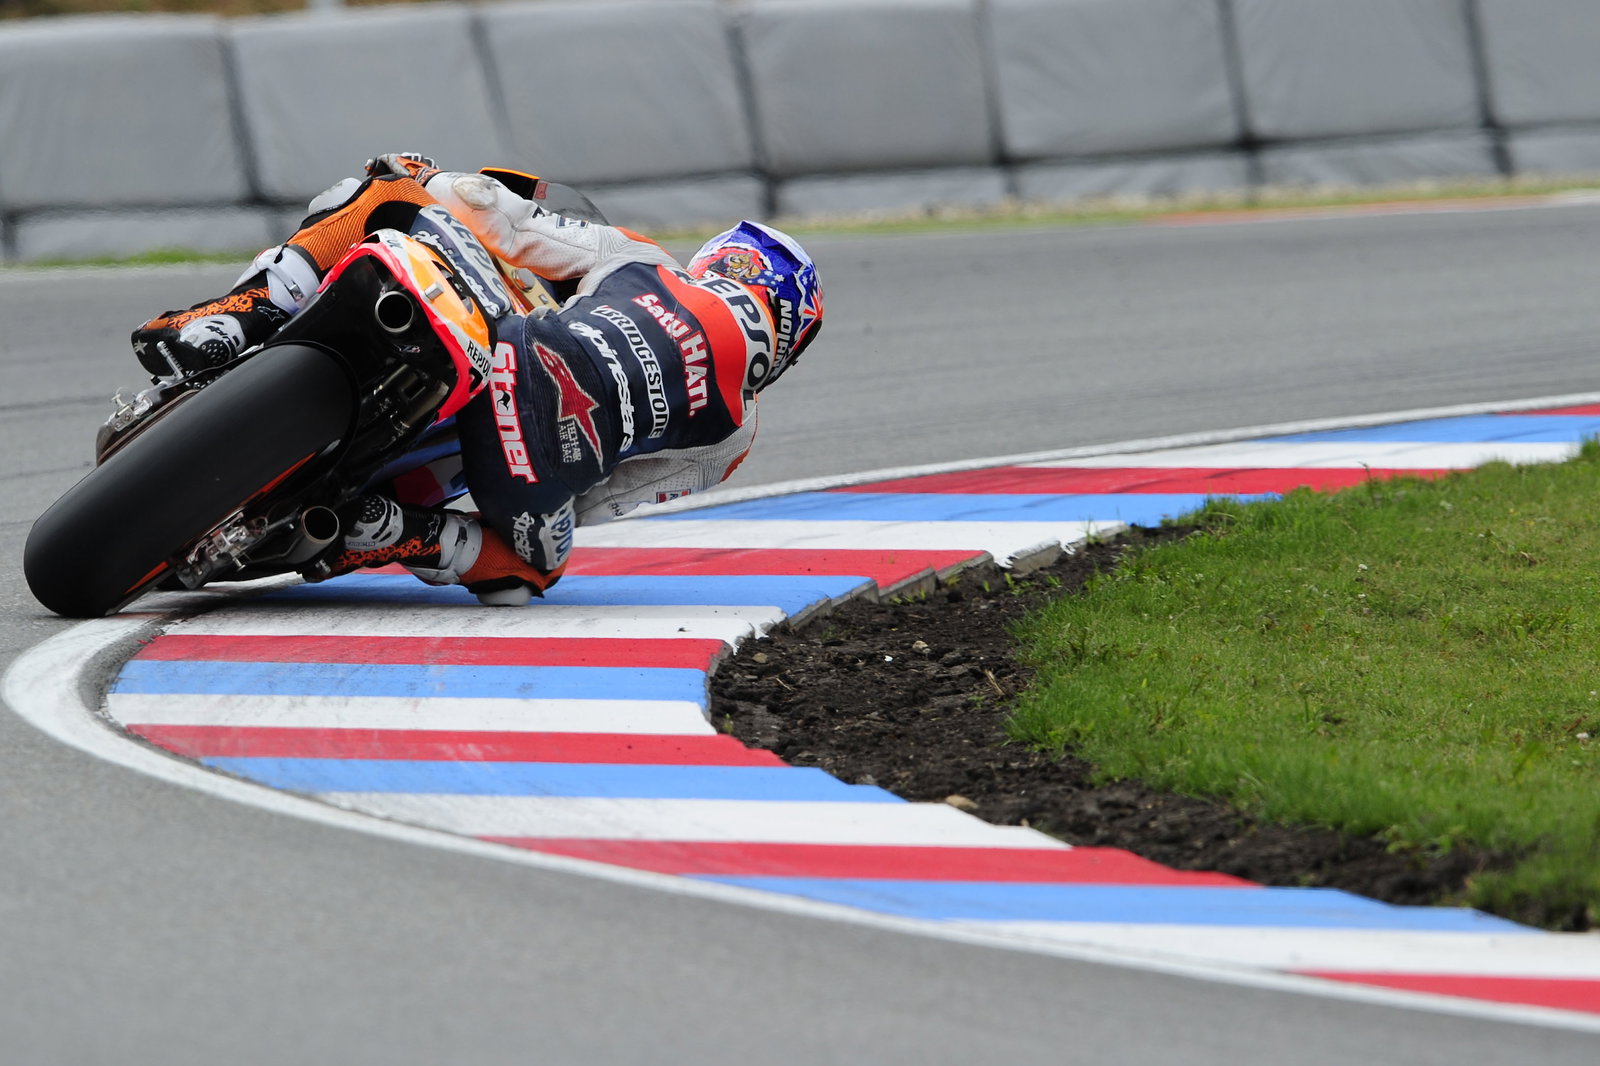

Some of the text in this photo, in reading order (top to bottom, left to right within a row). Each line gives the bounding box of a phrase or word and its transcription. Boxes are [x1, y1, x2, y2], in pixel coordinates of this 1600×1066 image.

[632, 293, 692, 343] Satu
[775, 298, 793, 368] NOLAN
[489, 341, 538, 483] Stoner
[569, 321, 635, 452] alpinestars
[590, 305, 669, 438] BRIDGESTONE
[559, 424, 573, 463] AIR BAG
